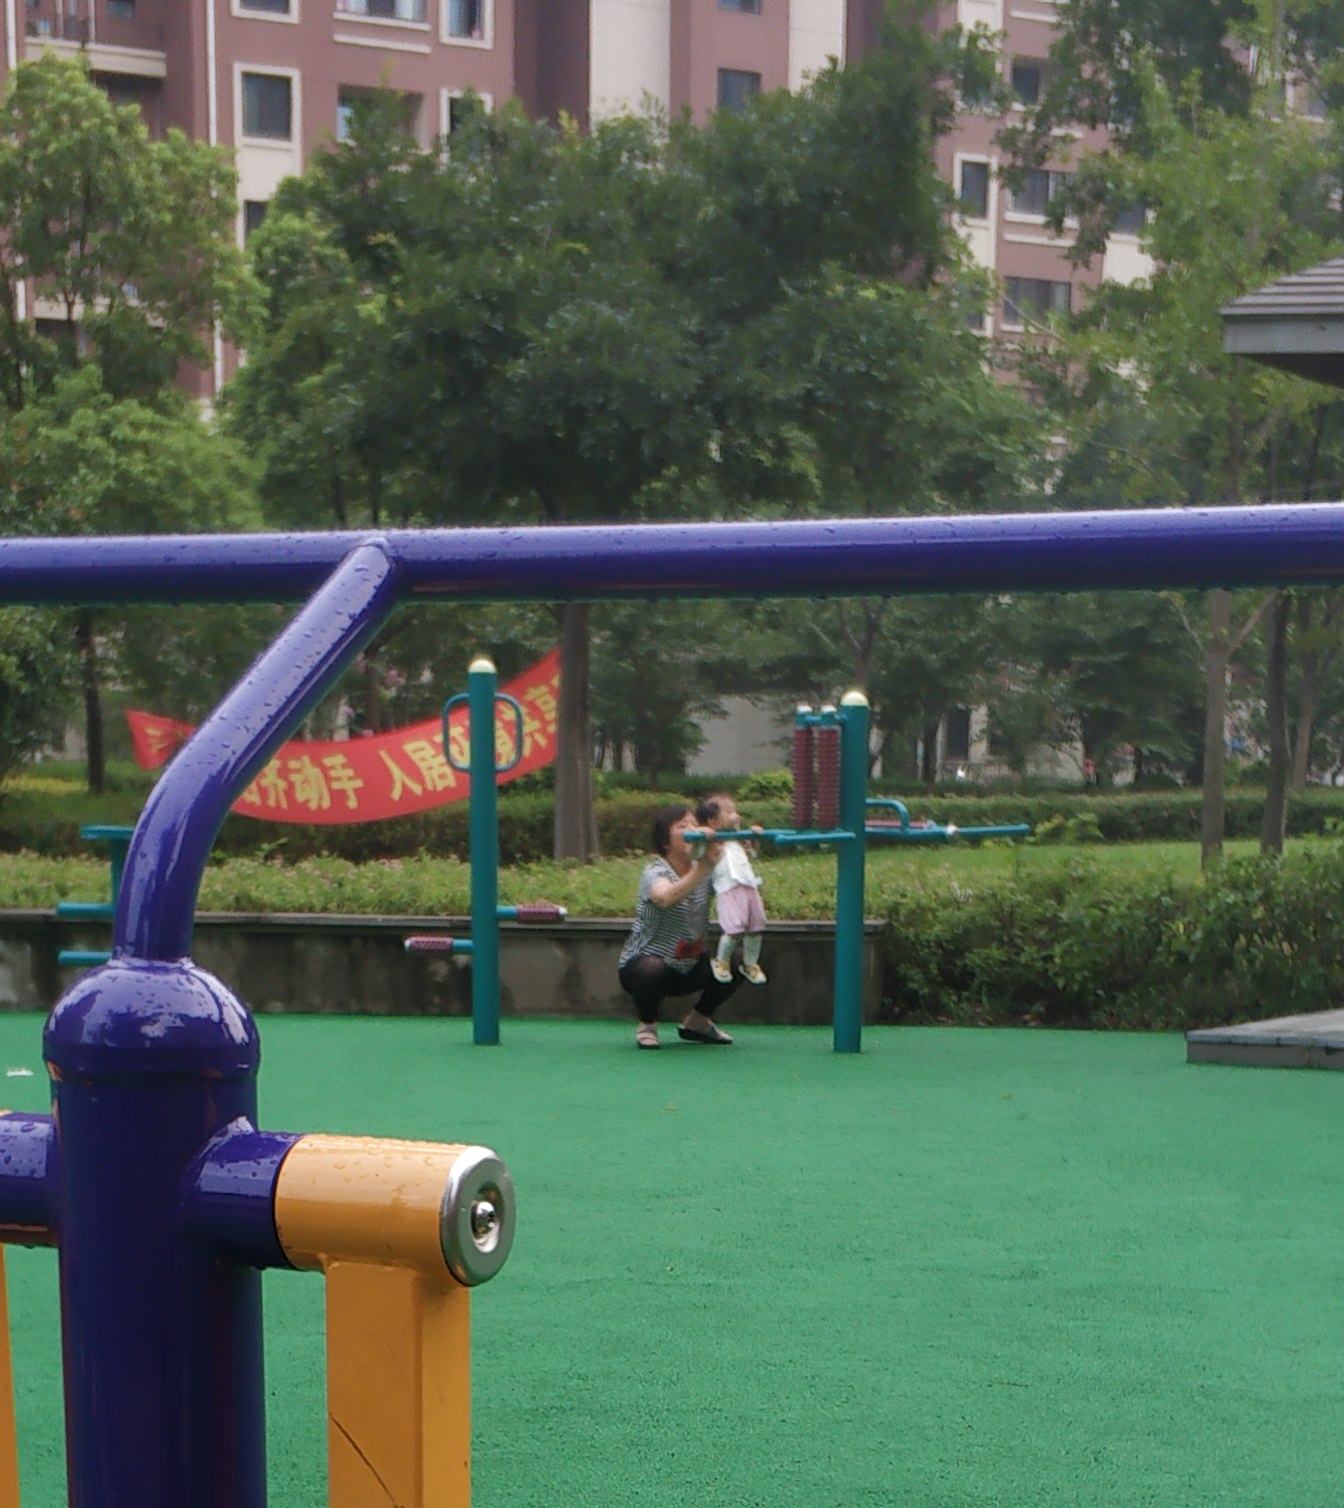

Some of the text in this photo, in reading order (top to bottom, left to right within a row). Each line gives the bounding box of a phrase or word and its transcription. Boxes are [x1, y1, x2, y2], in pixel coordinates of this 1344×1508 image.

[378, 674, 560, 802] 人居环共享
